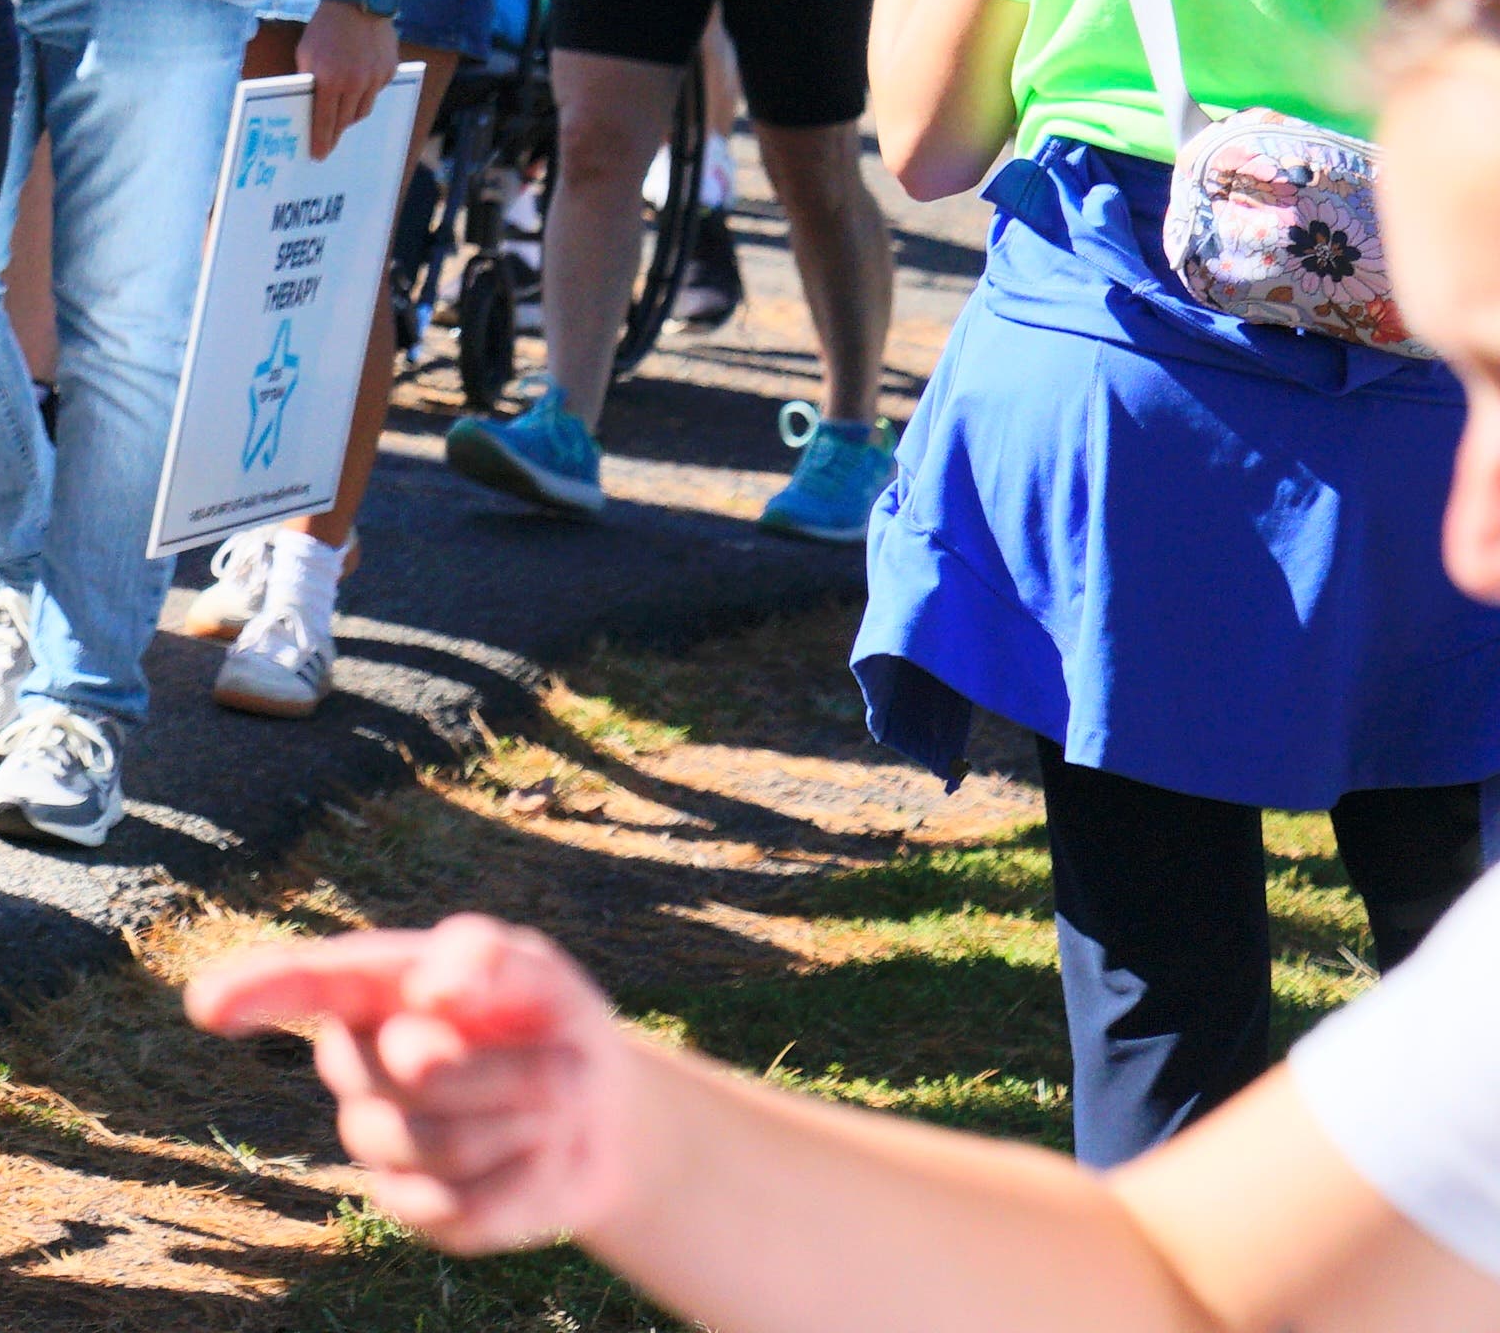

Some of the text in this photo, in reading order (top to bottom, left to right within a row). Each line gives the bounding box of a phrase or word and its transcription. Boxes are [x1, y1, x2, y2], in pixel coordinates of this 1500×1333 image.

[271, 192, 346, 232] MONTCLAIR
[274, 236, 326, 273] SPEECH
[263, 274, 323, 314] THERAPY
